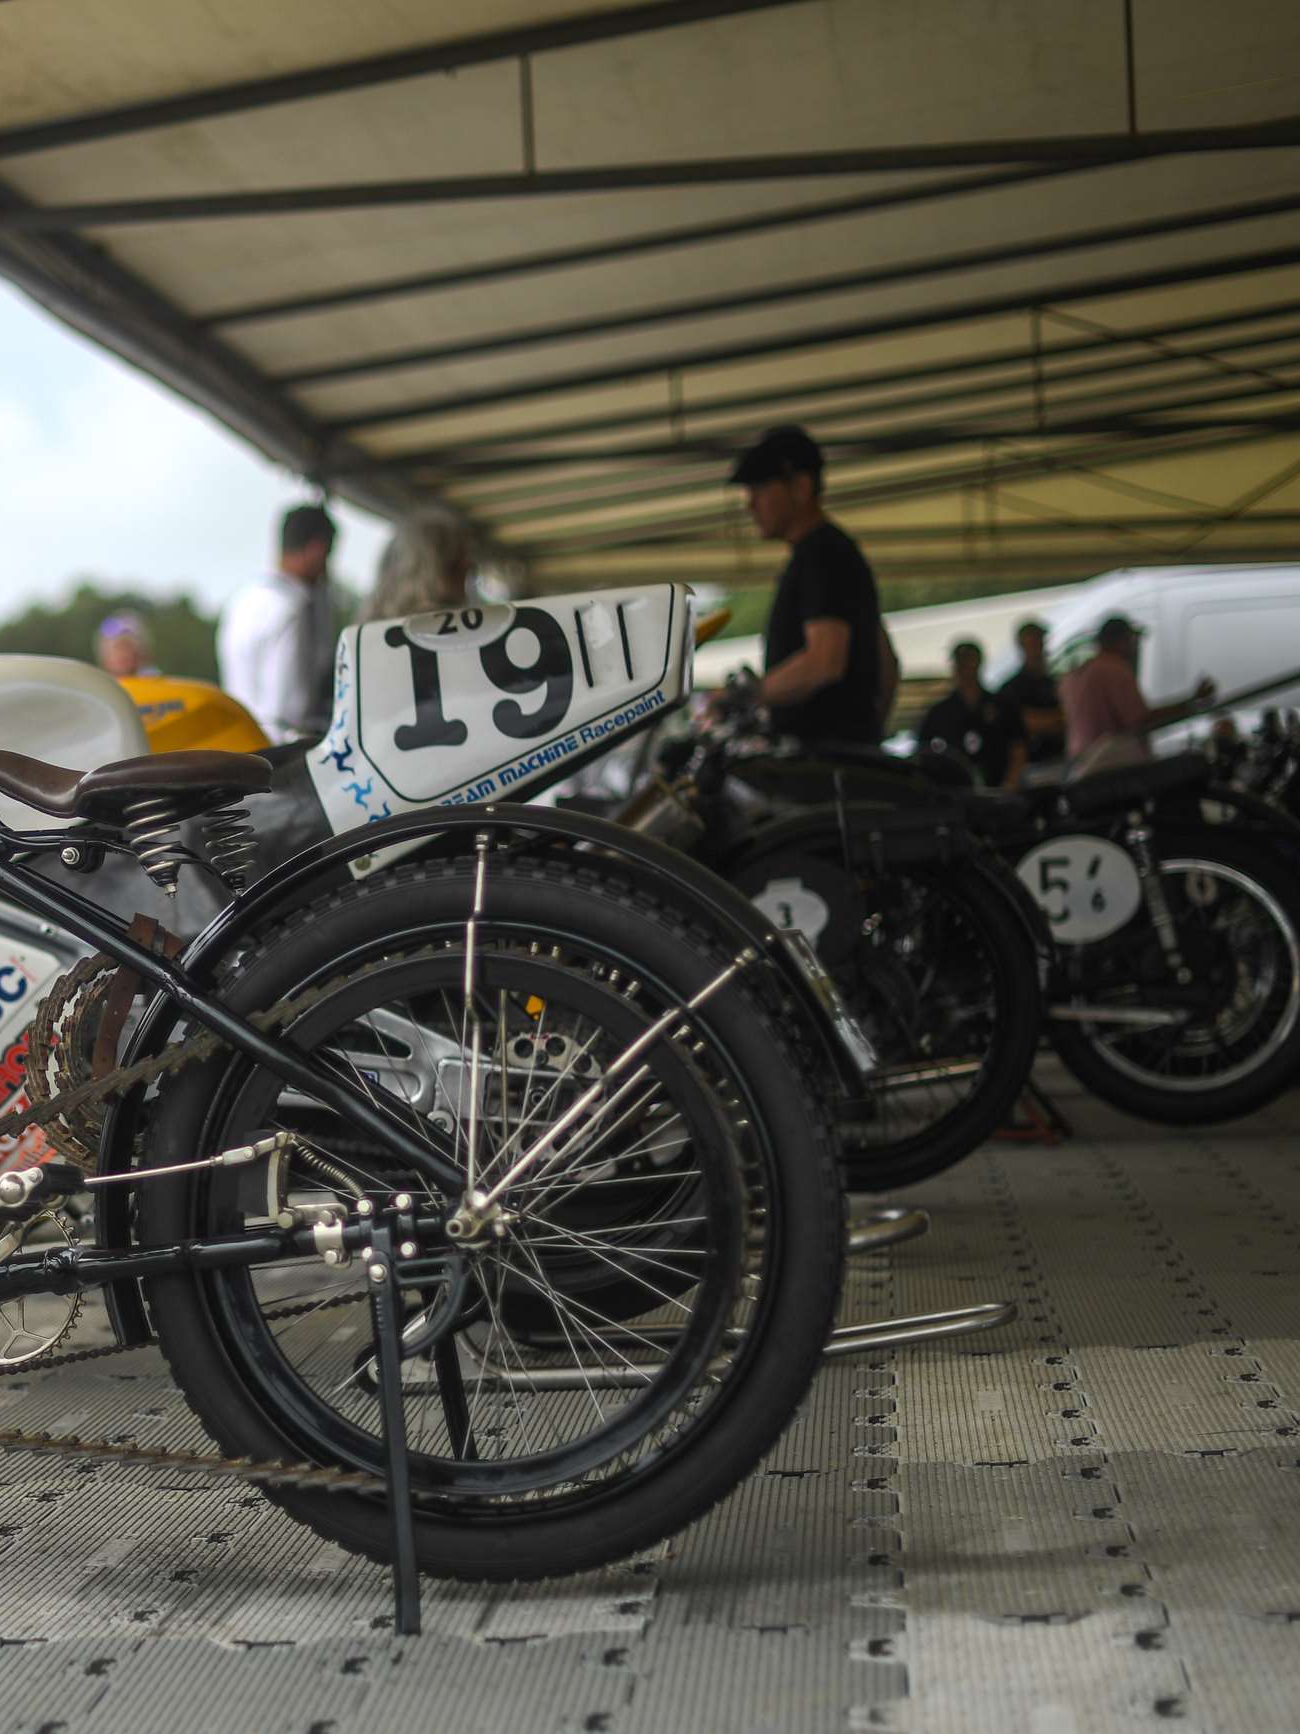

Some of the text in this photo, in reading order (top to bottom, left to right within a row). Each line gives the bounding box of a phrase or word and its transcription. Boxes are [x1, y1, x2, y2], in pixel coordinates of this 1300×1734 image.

[434, 608, 484, 635] 20
[384, 606, 574, 752] 19
[580, 690, 667, 744] Racepaint
